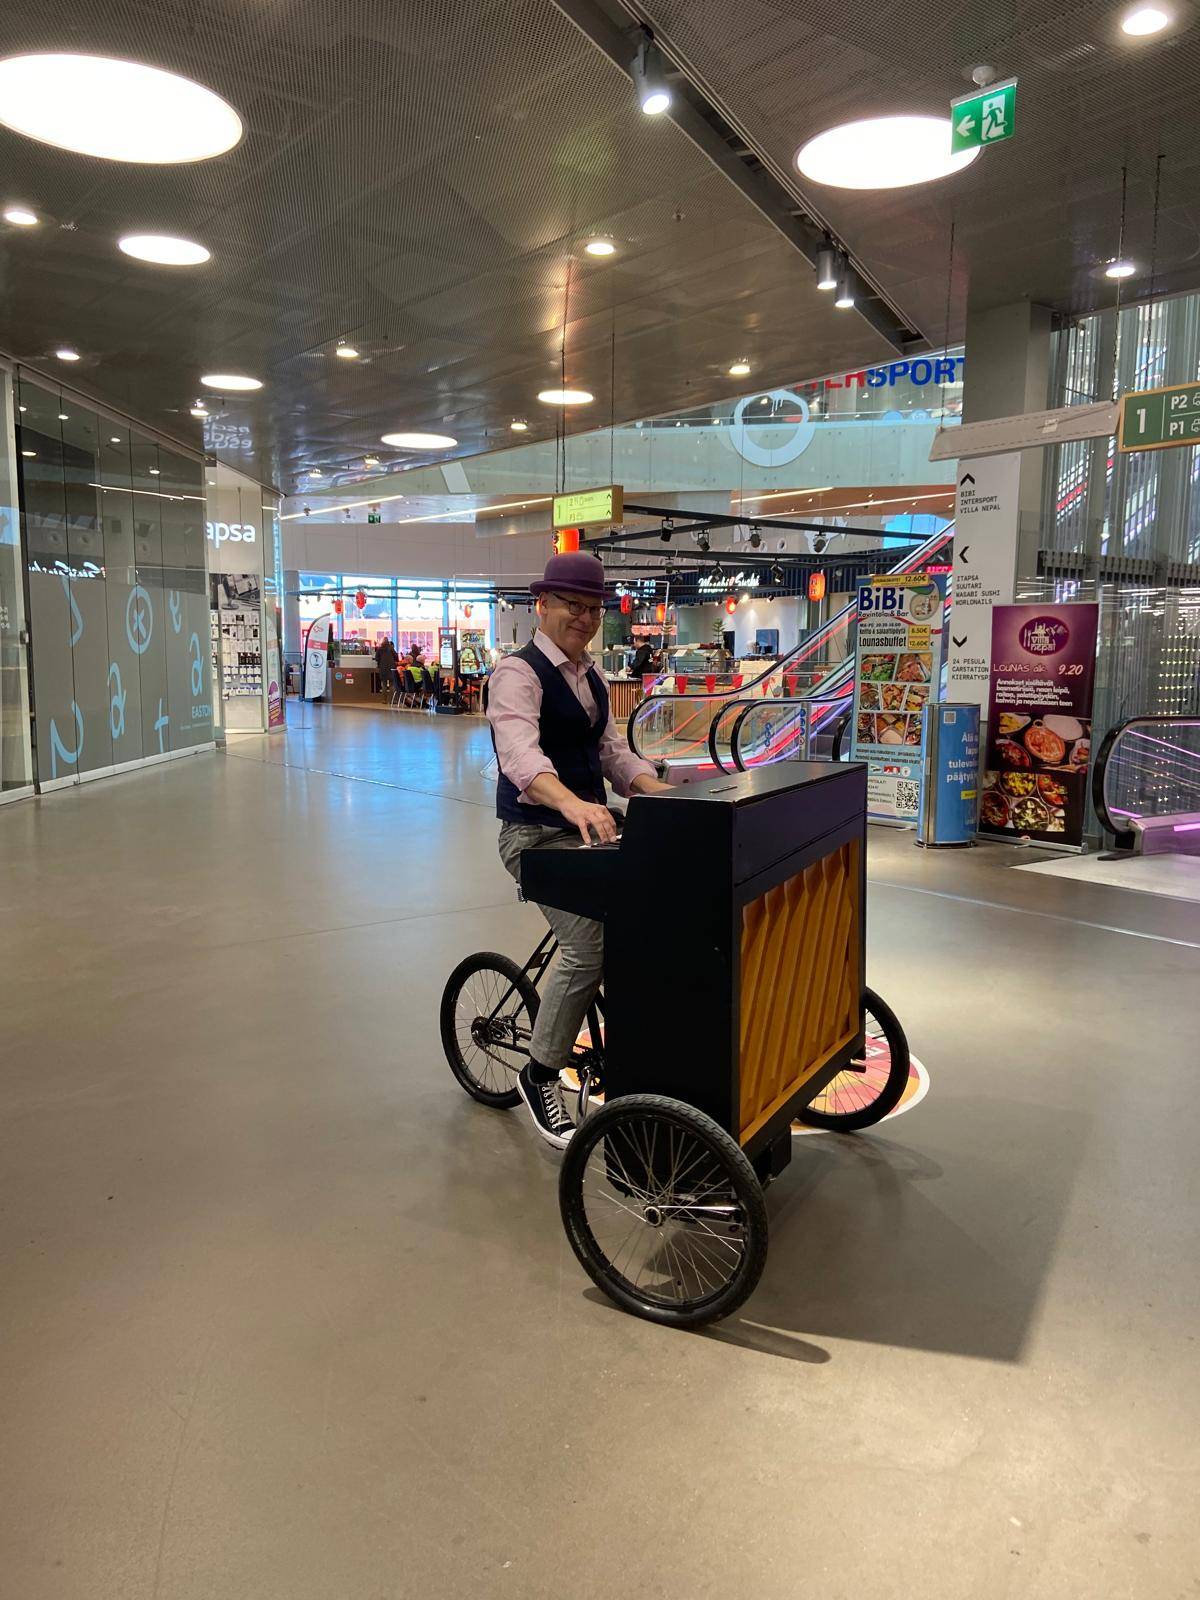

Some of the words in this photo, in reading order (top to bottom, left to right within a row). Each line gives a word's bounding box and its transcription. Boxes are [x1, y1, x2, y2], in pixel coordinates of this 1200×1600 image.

[1171, 394, 1188, 410] P2
[1136, 408, 1146, 434] 1
[1169, 421, 1185, 436] P1
[960, 489, 976, 498] BIBI
[960, 496, 998, 506] INTERSPORT
[960, 506, 979, 514] VILLA
[981, 504, 1001, 512] NEPAL
[956, 582, 982, 590] SUUTARI
[859, 587, 904, 610] BiBi
[955, 590, 978, 598] WASABI
[981, 589, 1000, 597] SUSHI
[859, 636, 907, 647] Lounasbuffet
[1058, 664, 1084, 676] 9.20
